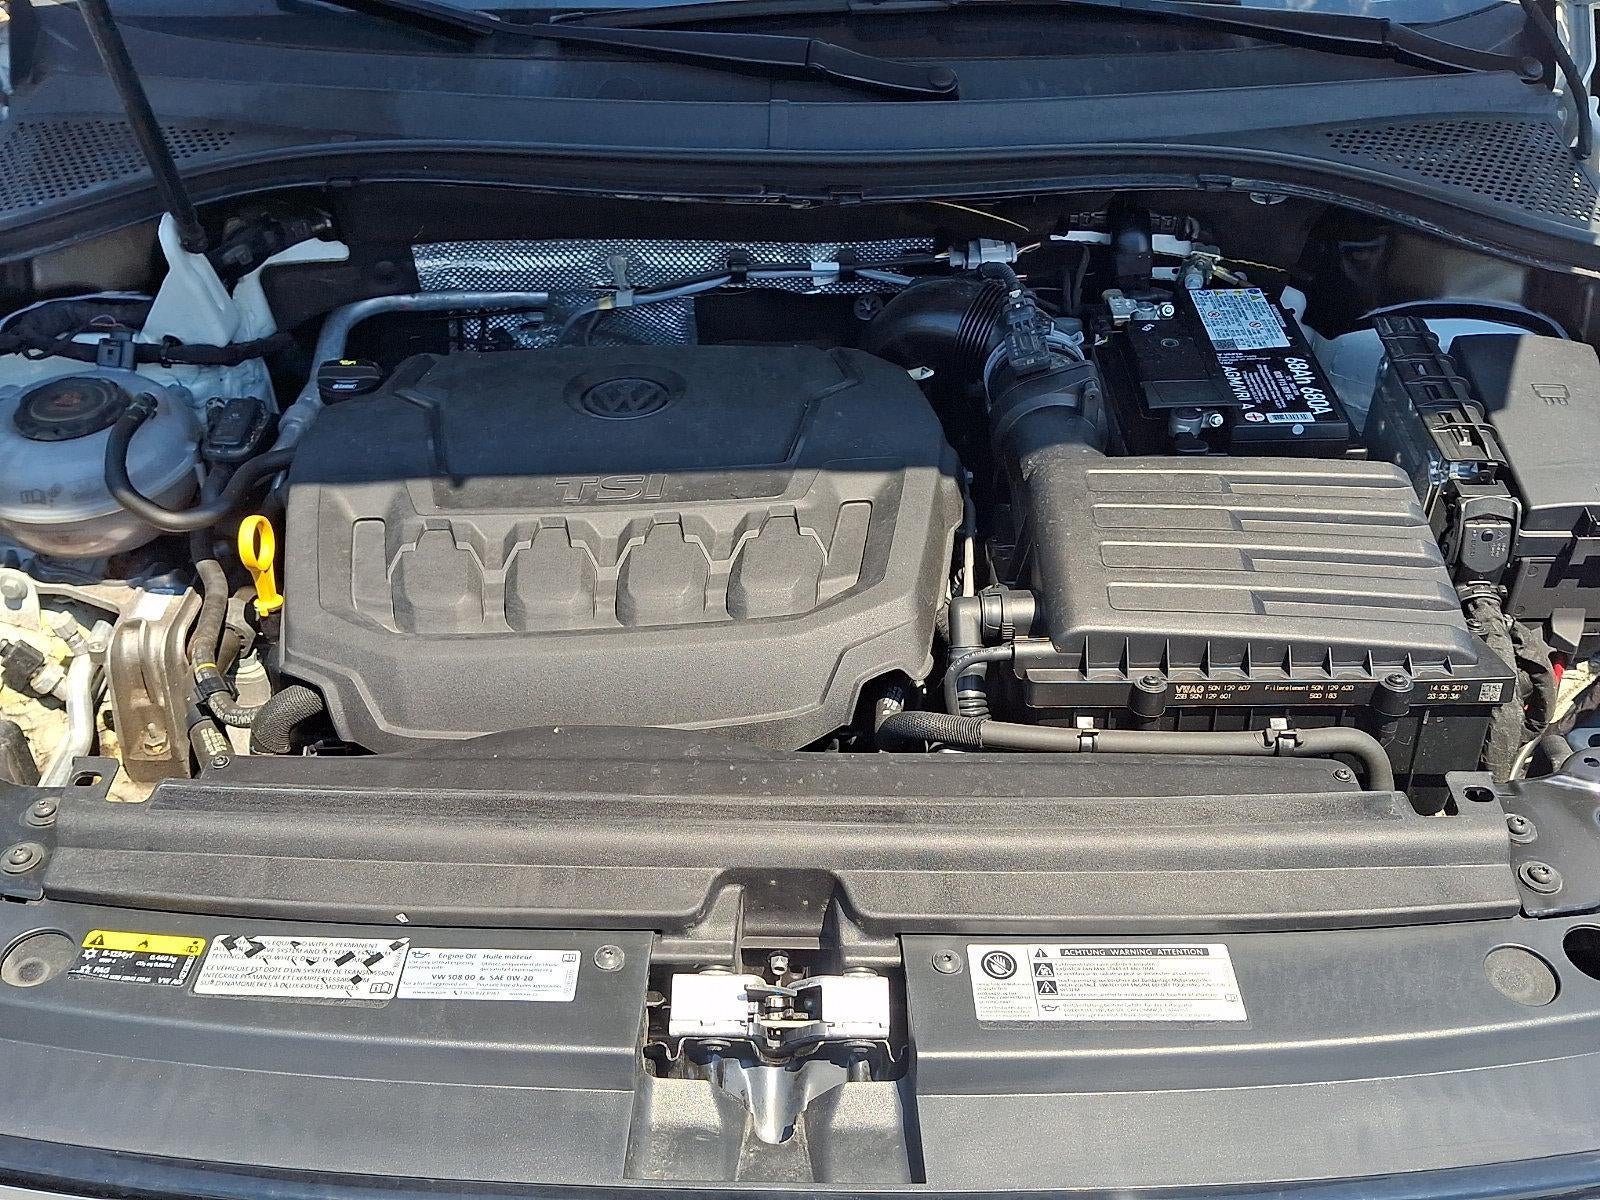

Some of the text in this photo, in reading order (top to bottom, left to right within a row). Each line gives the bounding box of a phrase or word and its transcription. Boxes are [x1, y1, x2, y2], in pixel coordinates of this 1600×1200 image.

[583, 378, 670, 419] VW
[1284, 357, 1316, 385] 68Ah
[1301, 386, 1333, 414] 680A
[555, 474, 668, 502] TSI
